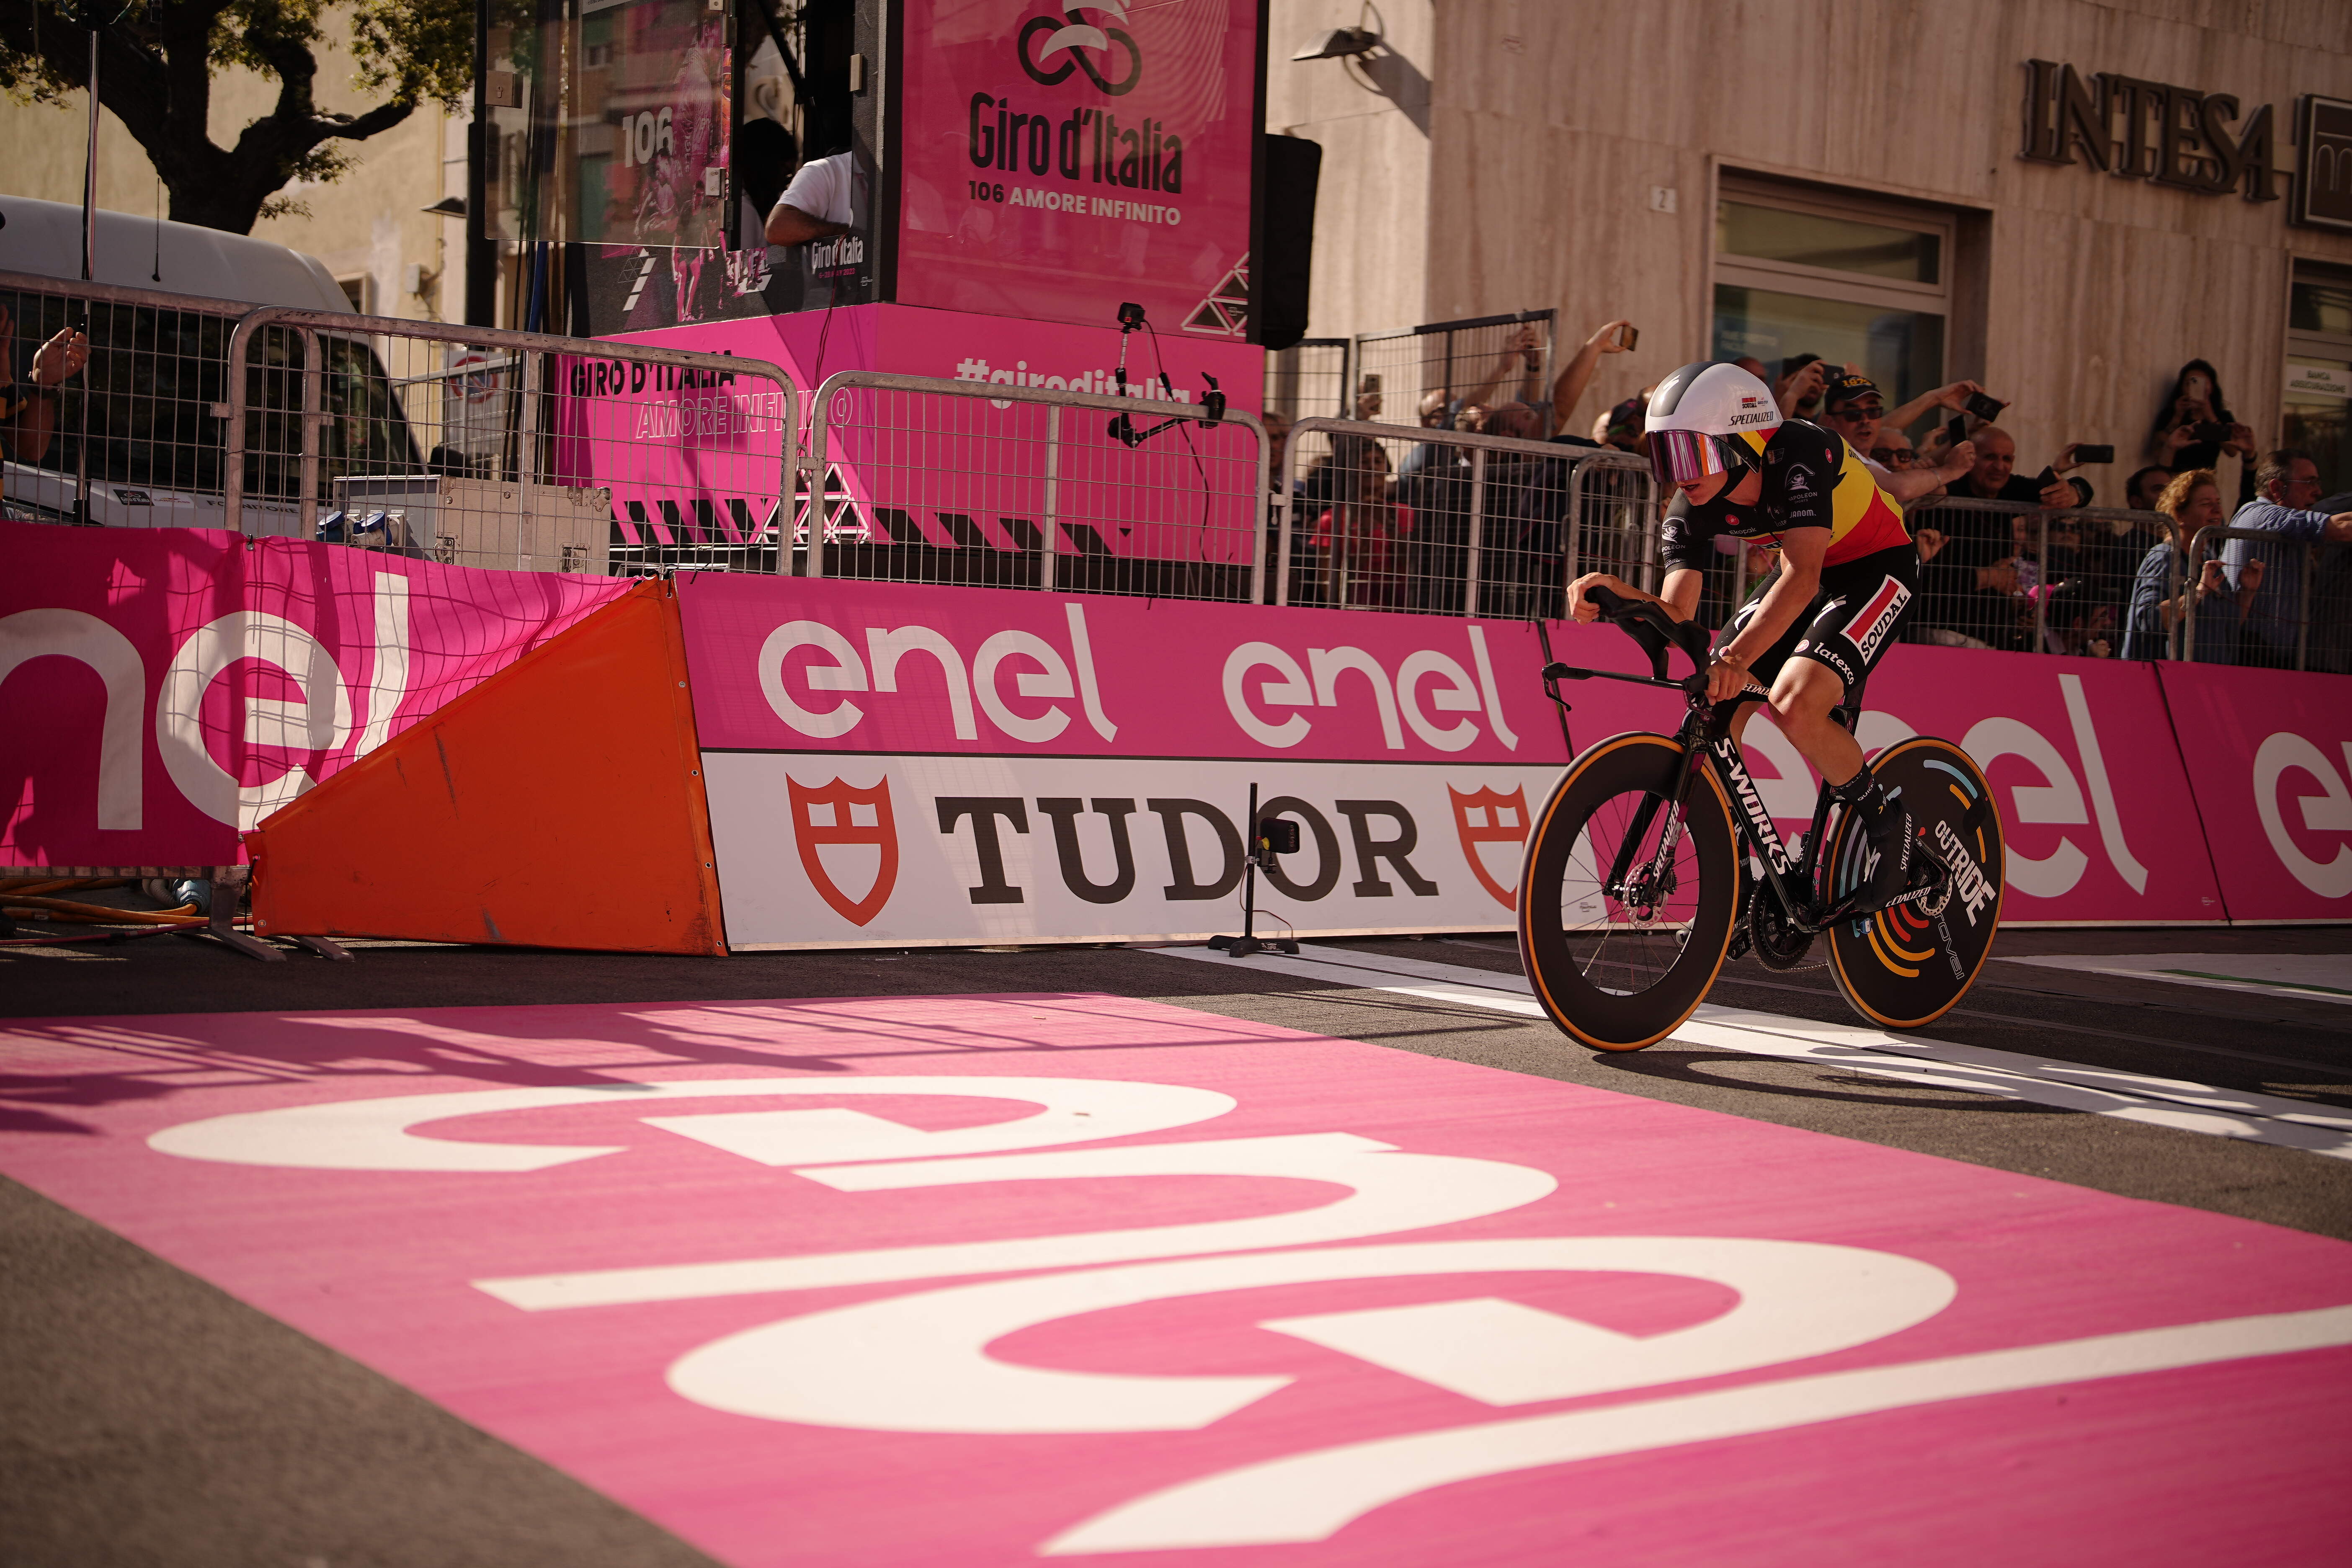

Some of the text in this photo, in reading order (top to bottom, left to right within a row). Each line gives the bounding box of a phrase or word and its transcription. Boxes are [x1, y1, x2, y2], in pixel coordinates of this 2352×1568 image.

[623, 106, 674, 168] 106
[969, 92, 1182, 194] Giro d'Italia
[2019, 58, 2280, 201] INTESA
[968, 181, 1181, 226] 106 AMORE INFINITO
[812, 241, 831, 270] Giro
[570, 361, 625, 397] GIRO
[636, 396, 728, 439] AMORE
[1728, 411, 1774, 426] SPECIALIZED
[206, 500, 299, 513] FONITORE
[1788, 491, 1818, 502] NAPOLEON
[1729, 527, 1757, 535] Ekopak
[1861, 593, 1908, 659] SOUDAL
[758, 603, 1118, 743] enel
[1222, 625, 1519, 752] enel
[1814, 642, 1854, 685] latexco
[1714, 738, 1792, 875] S-WORKS
[935, 796, 1439, 902] TUDOR
[1653, 799, 1679, 883] SPECIALIZED
[1900, 812, 1912, 873] SPECIALIZED
[1935, 820, 1996, 928] OUTRIDE
